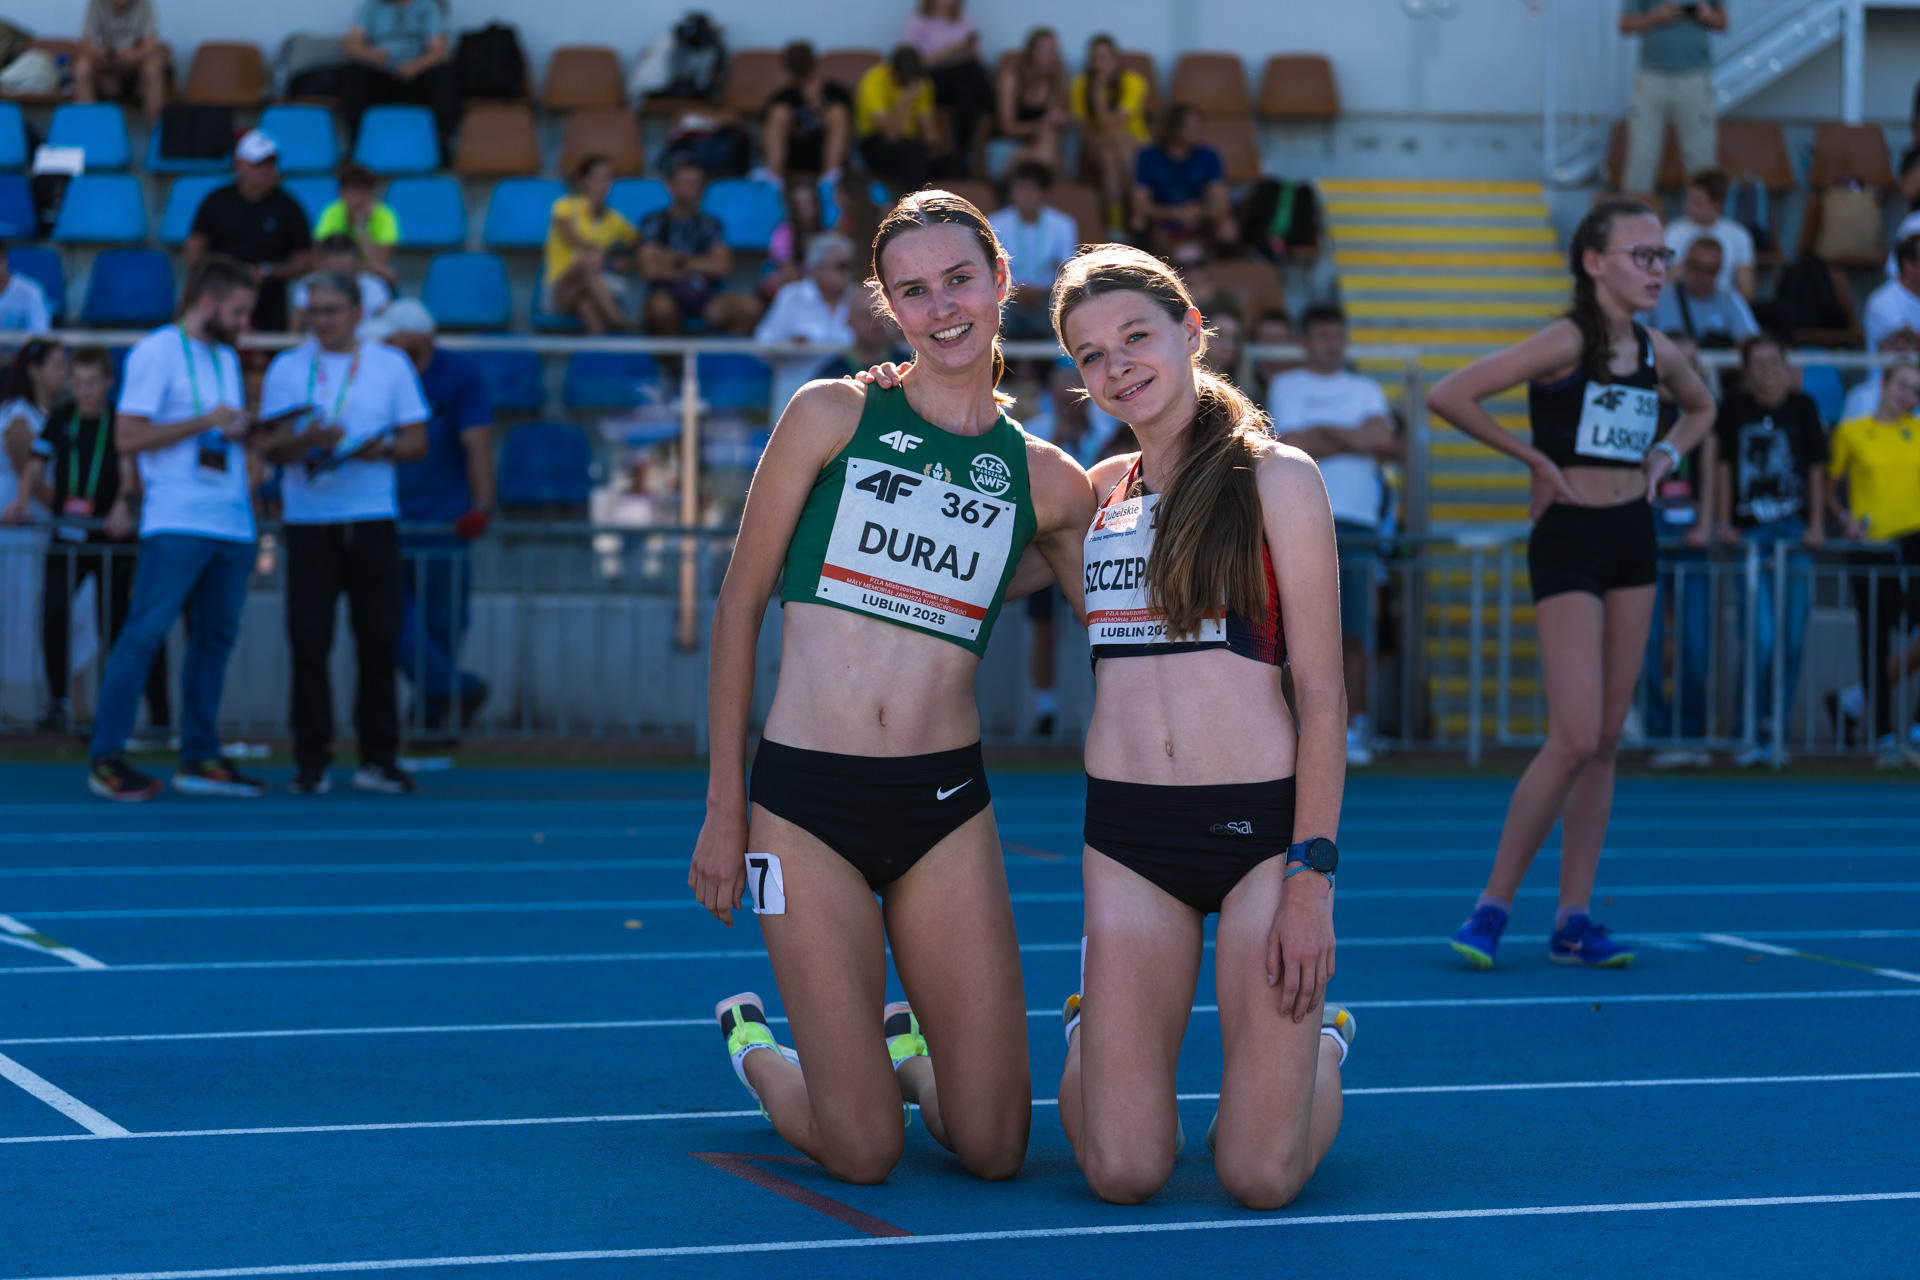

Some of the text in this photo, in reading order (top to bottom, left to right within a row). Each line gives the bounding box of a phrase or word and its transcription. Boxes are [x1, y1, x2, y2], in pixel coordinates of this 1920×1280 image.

[1592, 388, 1626, 411] 4F
[878, 430, 924, 453] 4F
[975, 467, 1006, 480] WARSZAWA
[980, 459, 1003, 474] AZS
[856, 469, 922, 504] 4F
[976, 474, 1004, 489] AWF
[941, 492, 1001, 529] 367
[858, 521, 980, 581] DURAJ
[1085, 557, 1147, 595] SZCZEP
[846, 577, 862, 586] MAŁY
[863, 582, 894, 595] MEMORIAŁ
[894, 590, 921, 603] JANUSZA
[869, 577, 884, 586] PZLA
[885, 581, 921, 596] Mistrzostwa
[921, 591, 940, 601] Polski
[861, 593, 946, 625] LUBLIN 2025
[1100, 625, 1169, 637] LUBLIN 202
[749, 858, 769, 909] 7
